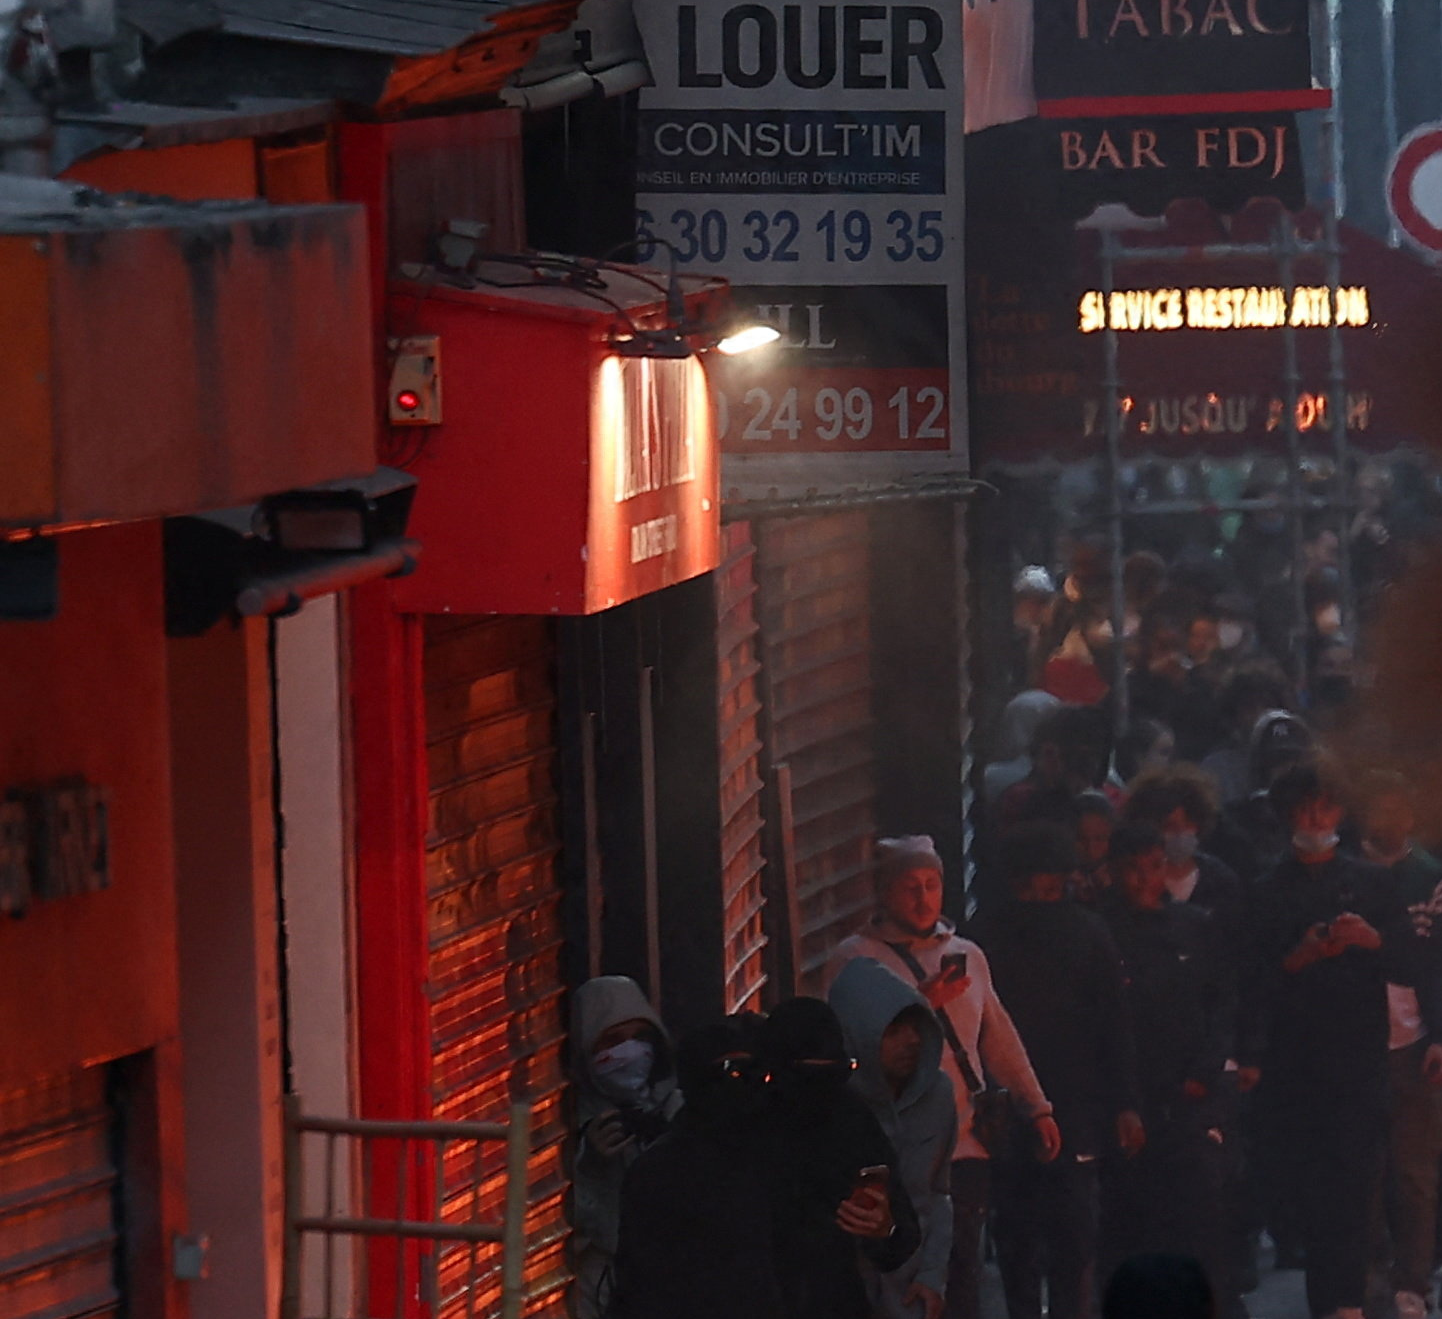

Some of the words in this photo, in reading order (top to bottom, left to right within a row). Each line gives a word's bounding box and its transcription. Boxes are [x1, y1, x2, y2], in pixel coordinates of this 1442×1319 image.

[677, 4, 947, 91] LOUER
[653, 121, 922, 158] CONSULT'IM
[1059, 127, 1168, 172] BAR
[1195, 126, 1290, 181] FDJ
[689, 171, 713, 186] EN
[716, 170, 808, 187] IMMOBILIER
[812, 170, 922, 186] D'ENTREPRISE
[671, 209, 729, 264] 30
[742, 209, 801, 263] 32
[815, 209, 873, 263] 19
[885, 209, 944, 263] 35
[742, 386, 803, 441] 24
[814, 386, 874, 441] 99
[888, 385, 947, 440] 12
